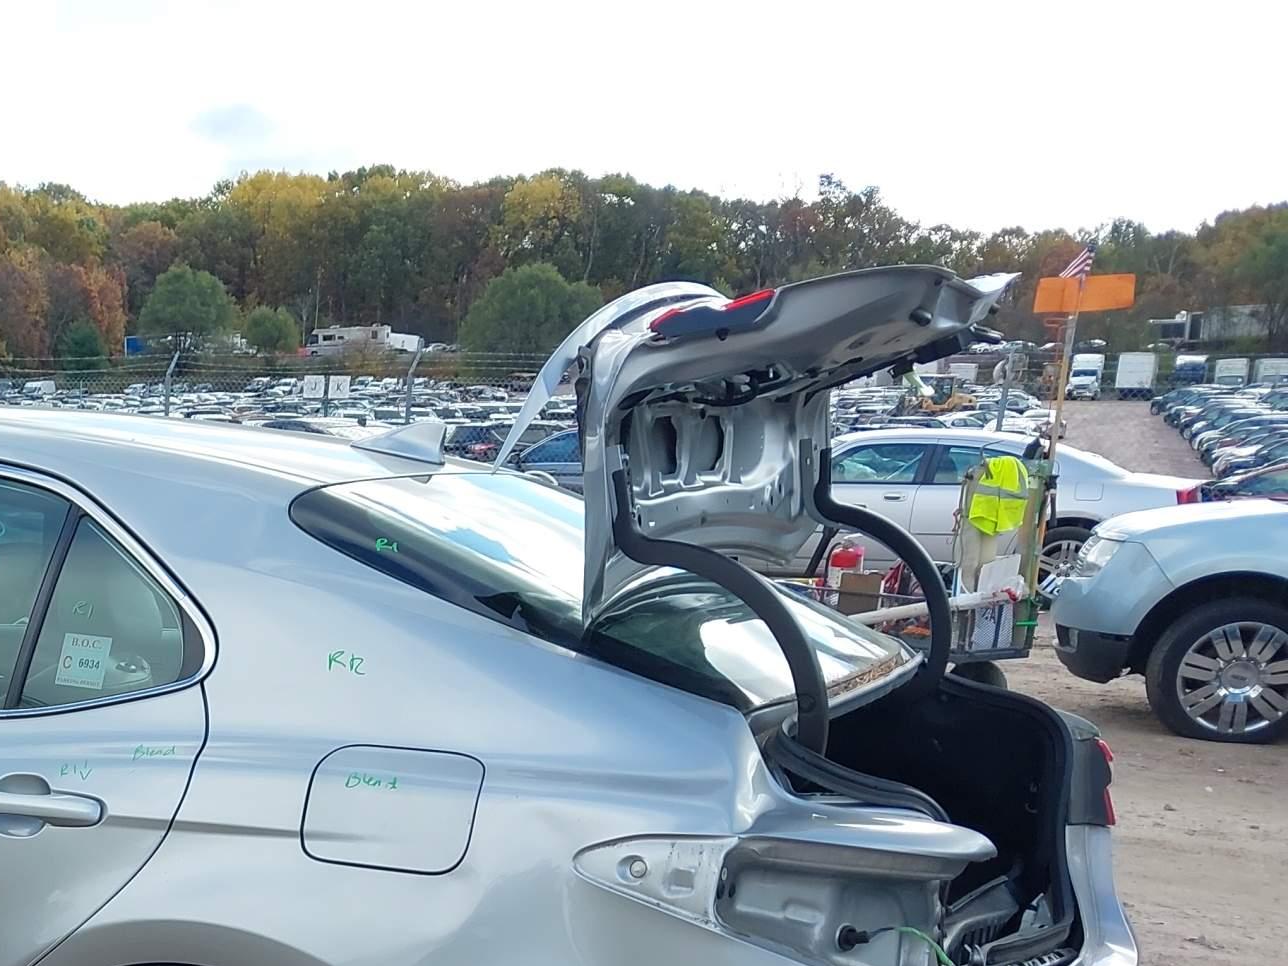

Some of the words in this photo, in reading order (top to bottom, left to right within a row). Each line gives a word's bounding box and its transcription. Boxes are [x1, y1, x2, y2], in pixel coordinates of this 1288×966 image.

[62, 655, 72, 669] C
[78, 657, 100, 670] 6934
[132, 744, 176, 761] Blend
